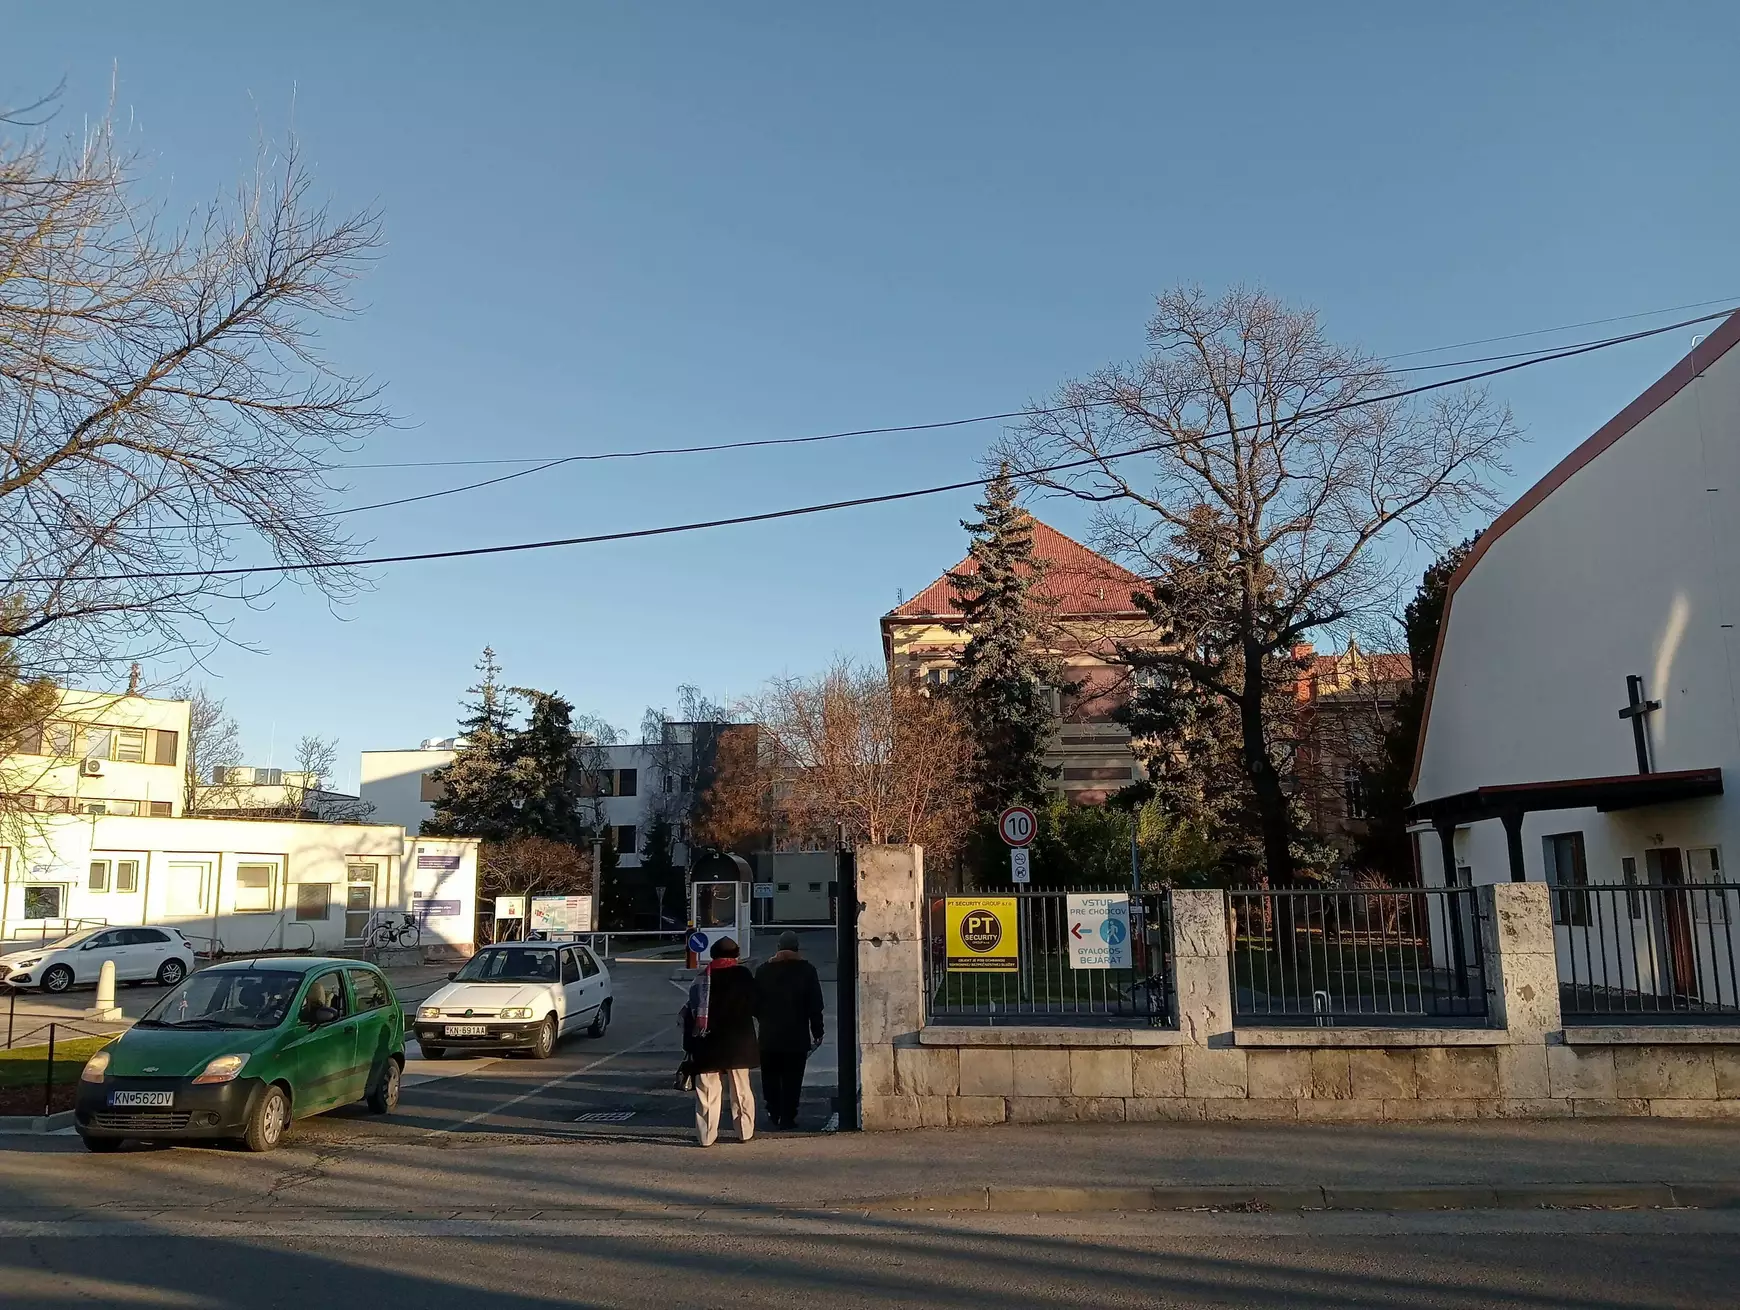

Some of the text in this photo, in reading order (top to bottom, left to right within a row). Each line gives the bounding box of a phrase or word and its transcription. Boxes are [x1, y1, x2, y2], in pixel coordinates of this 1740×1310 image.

[1008, 817, 1029, 836] 10
[1081, 898, 1113, 907] VSTUP
[968, 917, 994, 934] PT
[1077, 947, 1123, 955] GYALOGOS-
